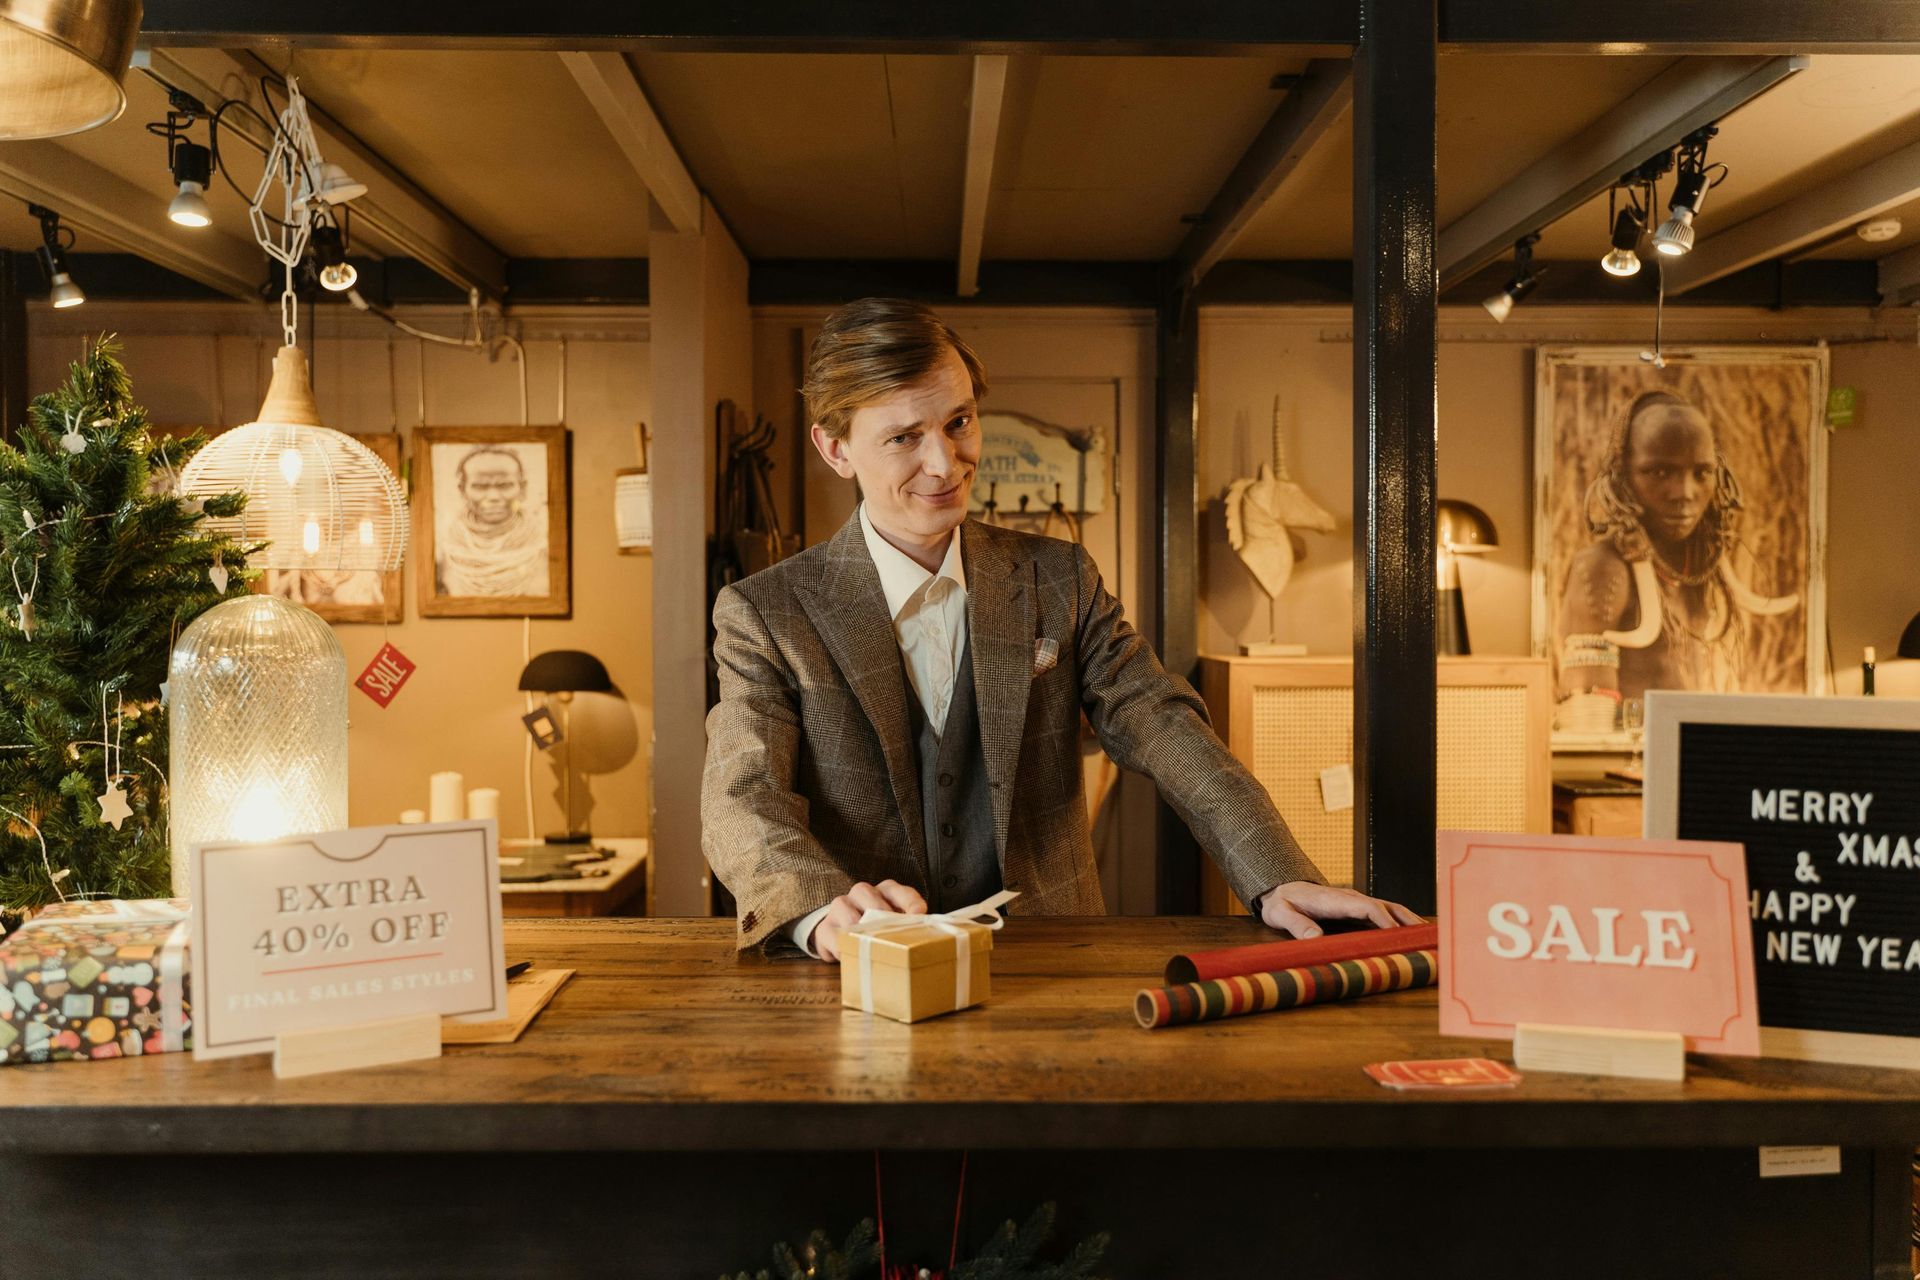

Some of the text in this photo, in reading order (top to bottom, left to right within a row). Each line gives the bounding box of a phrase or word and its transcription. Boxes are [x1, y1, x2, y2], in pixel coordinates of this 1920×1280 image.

[978, 456, 1017, 471] ATH
[1751, 788, 1873, 825] MERRY
[1794, 851, 1820, 883] &
[276, 875, 427, 914] EXTRA
[253, 912, 451, 957] 40% OFF
[1486, 902, 1697, 970] SALE
[1766, 931, 1842, 966] NEW
[228, 967, 475, 1012] FINAL SALES STYLES
